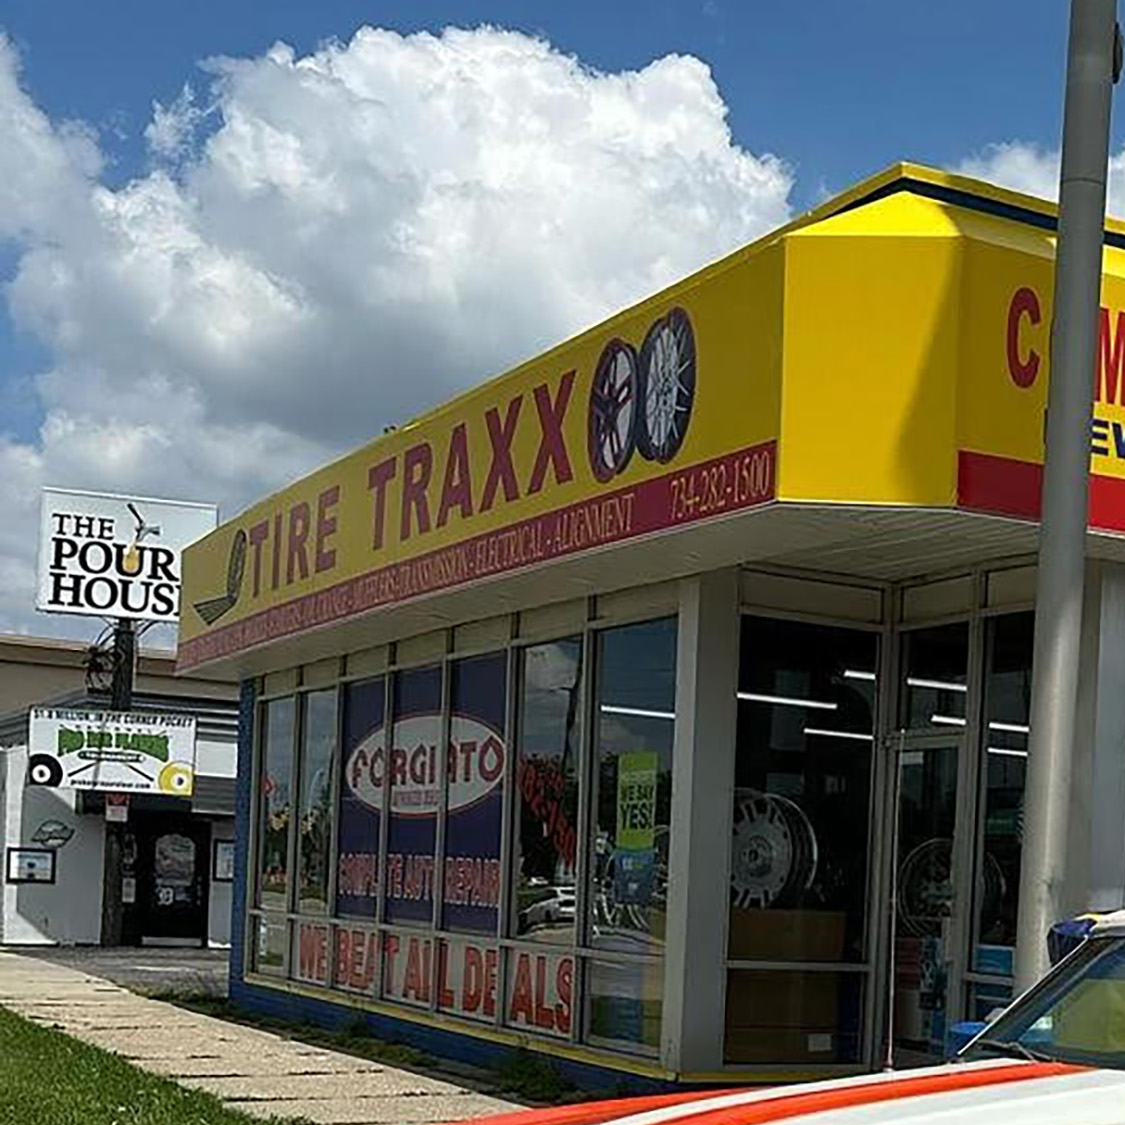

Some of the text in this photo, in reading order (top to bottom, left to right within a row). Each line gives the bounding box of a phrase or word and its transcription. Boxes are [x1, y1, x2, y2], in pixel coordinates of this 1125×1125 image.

[247, 370, 576, 599] TIRE TRAXX
[552, 493, 635, 553] ALIGNMENT
[669, 450, 771, 520] 734-282-1500
[50, 537, 180, 582] POUR
[52, 513, 115, 540] THE
[48, 572, 181, 616] HOUS
[462, 945, 574, 1035] DEALS
